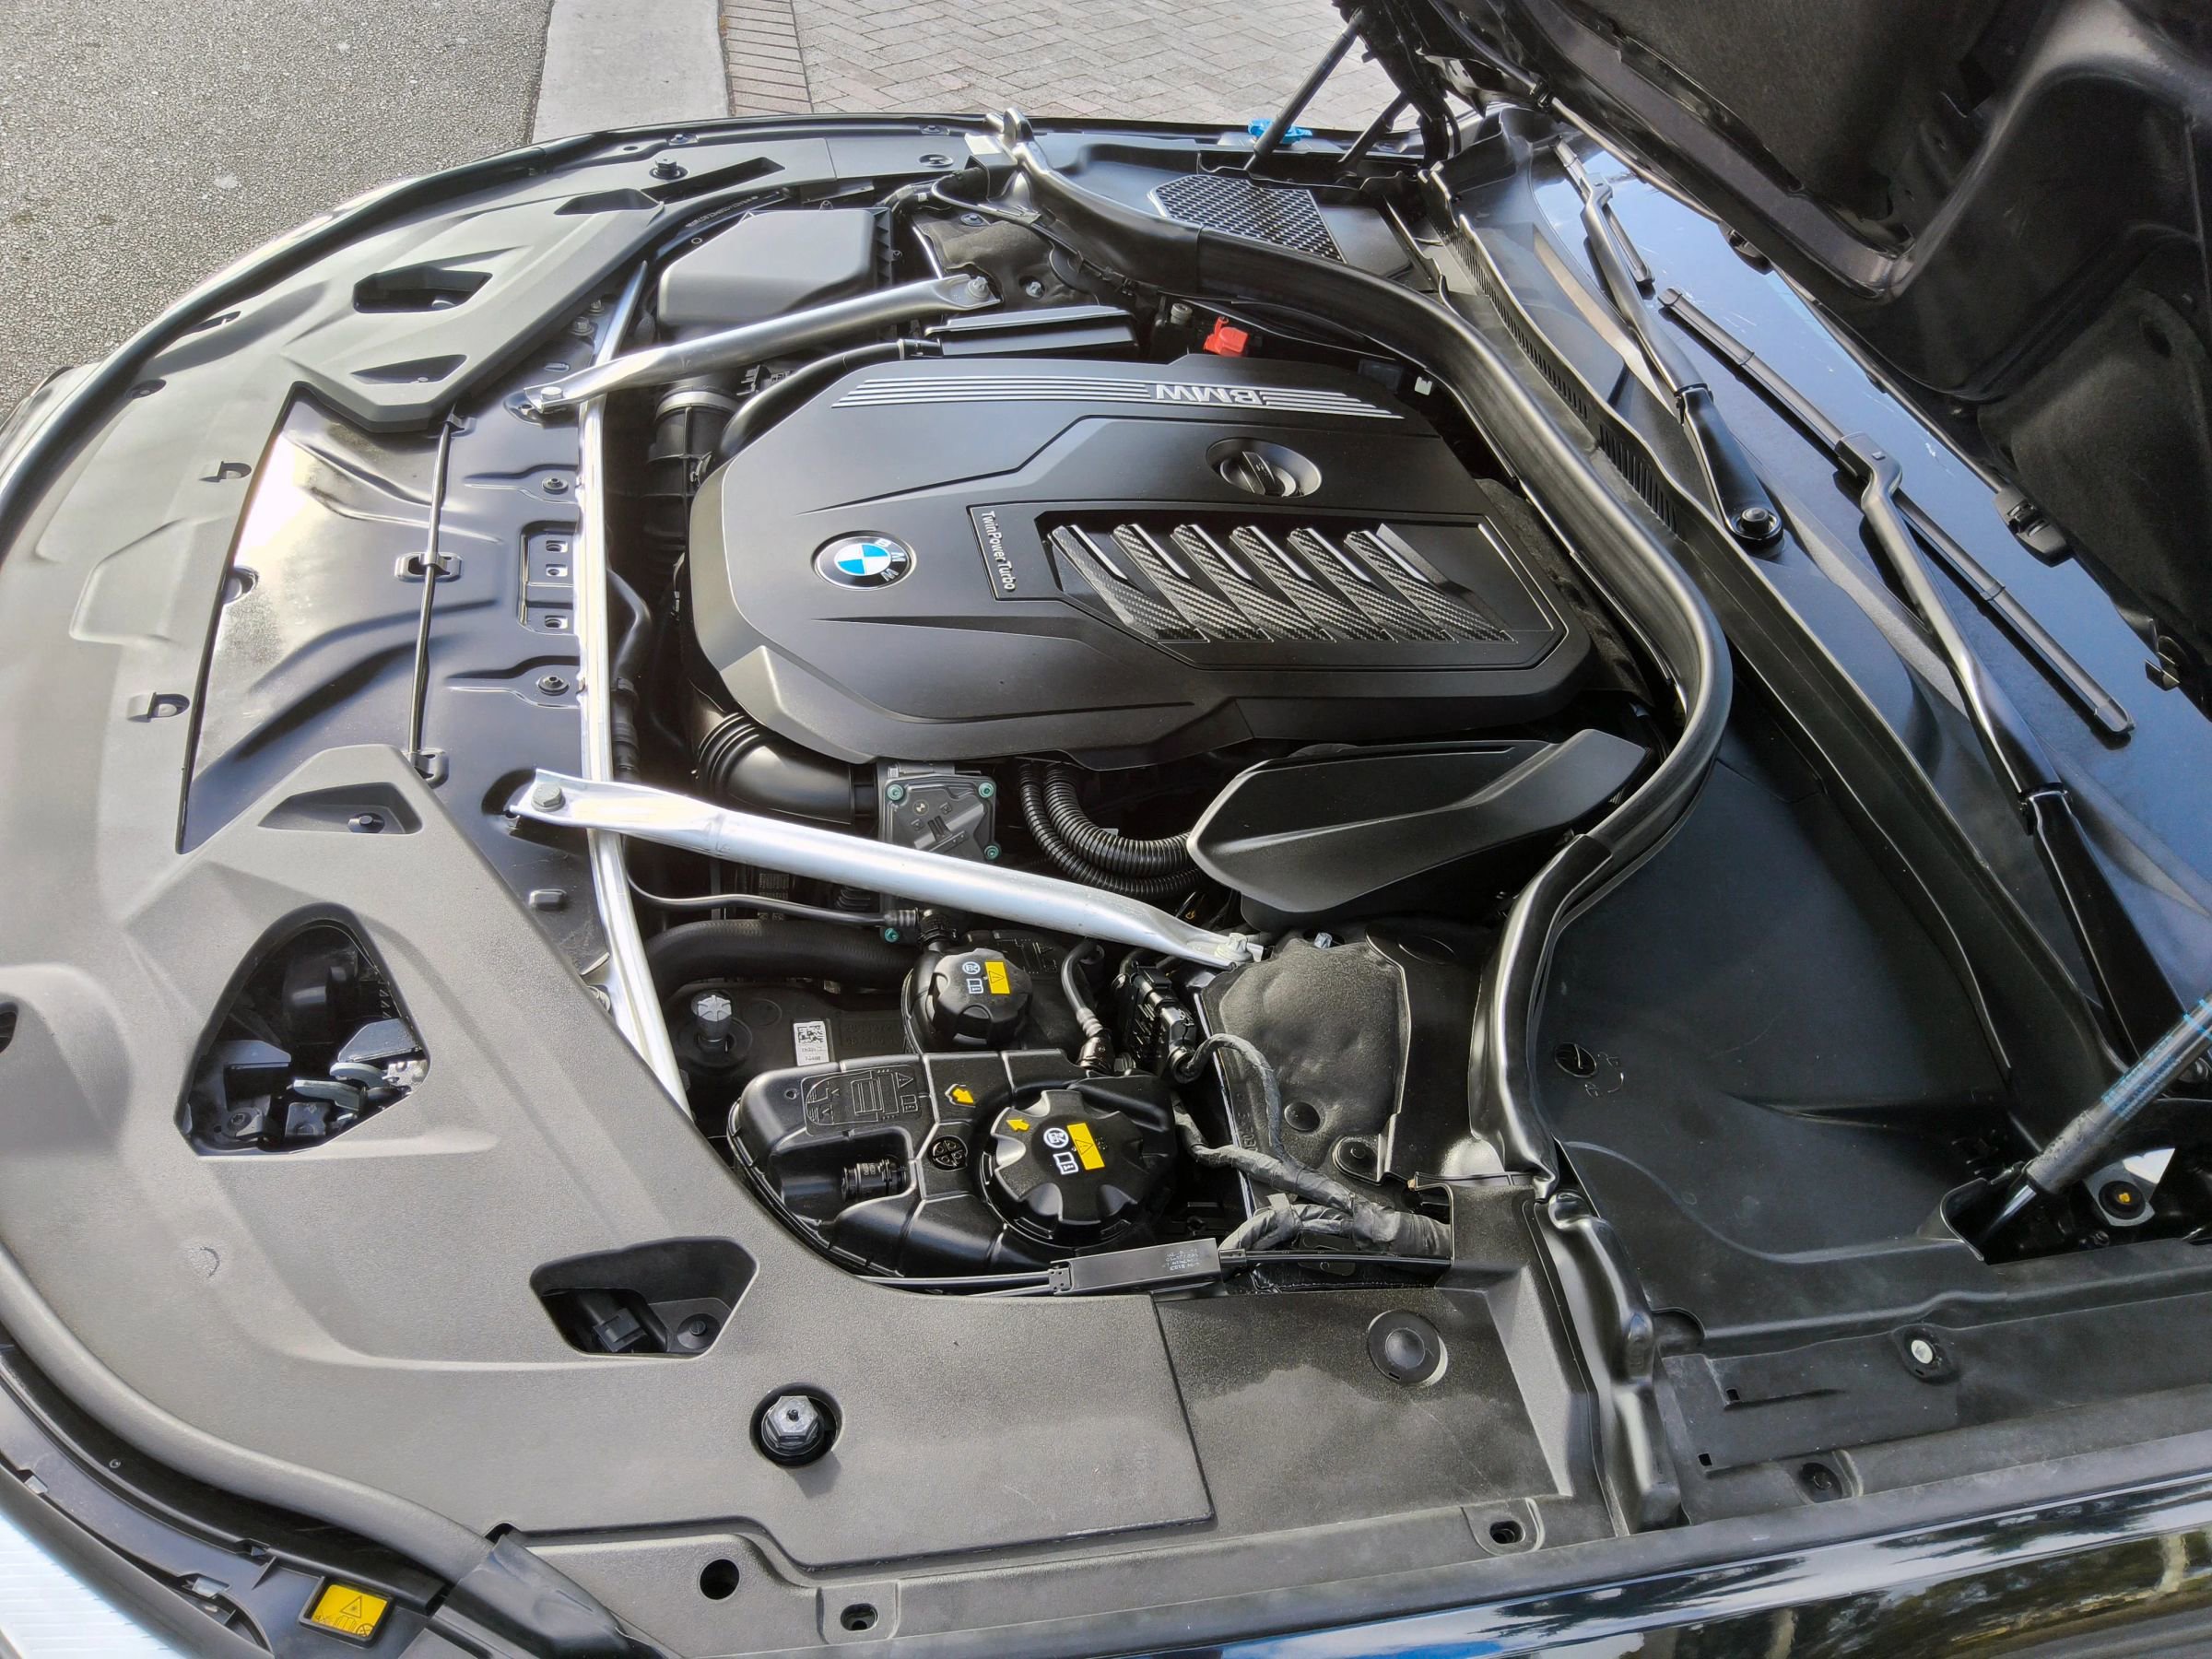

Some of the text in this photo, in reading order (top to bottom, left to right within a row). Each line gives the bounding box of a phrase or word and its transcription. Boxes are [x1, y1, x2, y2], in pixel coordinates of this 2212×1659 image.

[1156, 385, 1263, 405] BMW
[874, 537, 907, 582] BMW
[981, 511, 1016, 590] TwinPower Turbo
